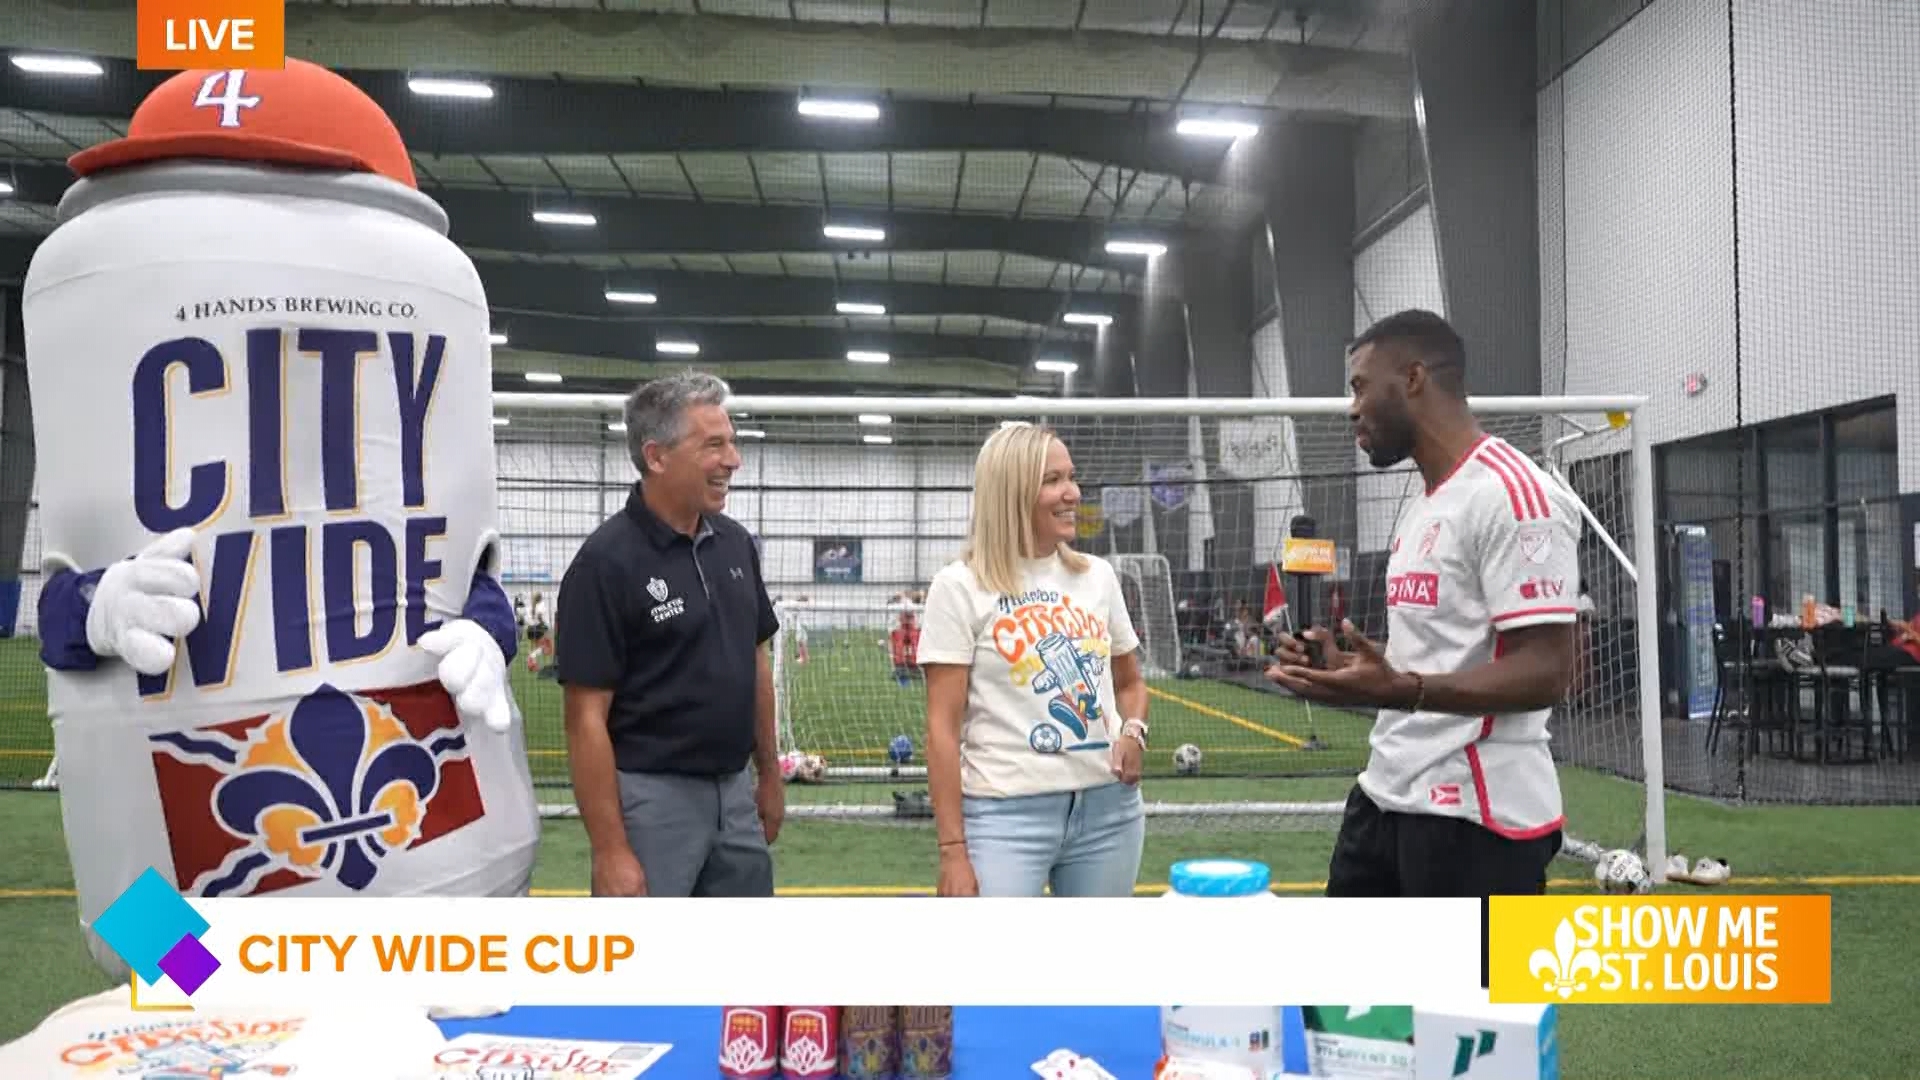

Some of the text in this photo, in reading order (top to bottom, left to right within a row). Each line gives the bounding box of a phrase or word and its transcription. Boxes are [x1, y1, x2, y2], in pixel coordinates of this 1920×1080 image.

[194, 69, 262, 127] 4
[175, 296, 418, 322] 4 HANDS BREWING CO.
[132, 327, 447, 534] CITY
